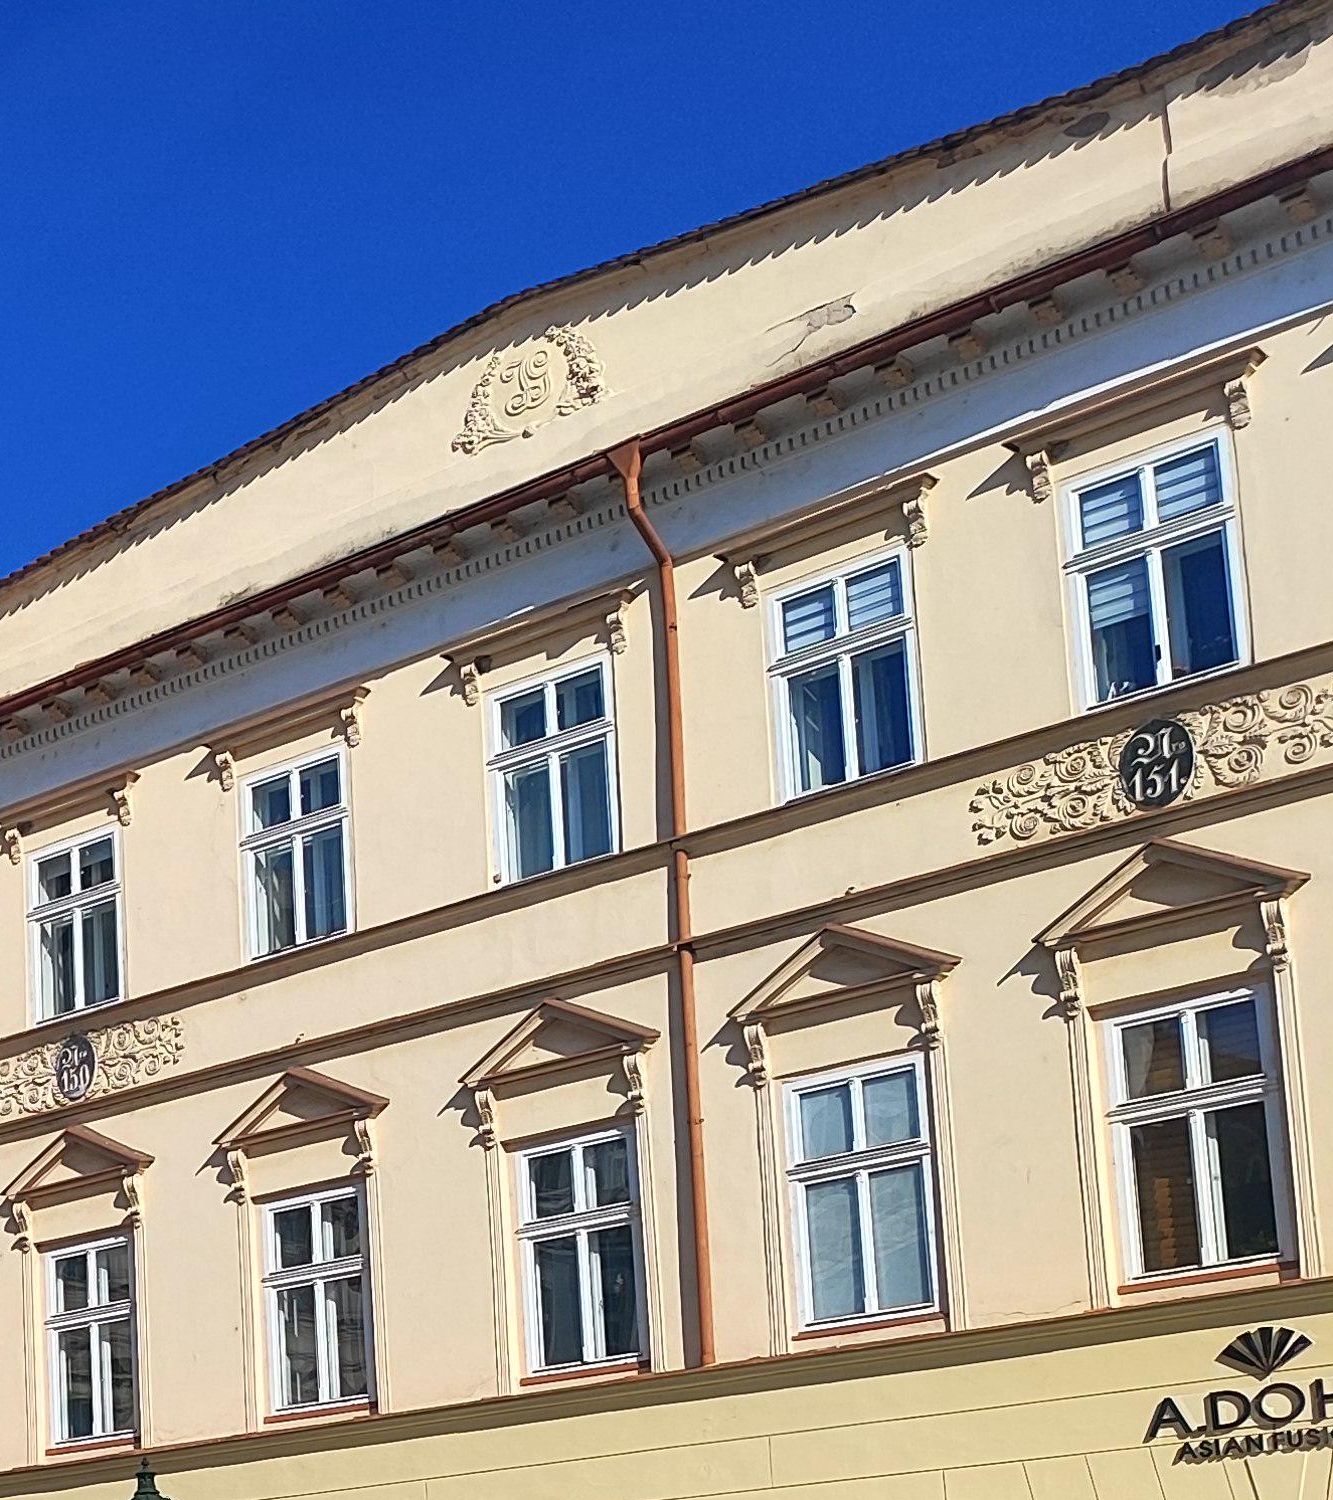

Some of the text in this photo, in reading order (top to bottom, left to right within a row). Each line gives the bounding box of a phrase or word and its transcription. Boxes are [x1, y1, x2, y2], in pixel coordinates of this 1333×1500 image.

[61, 1064, 90, 1092] 150
[1173, 1426, 1333, 1465] ASIAN FUSI
